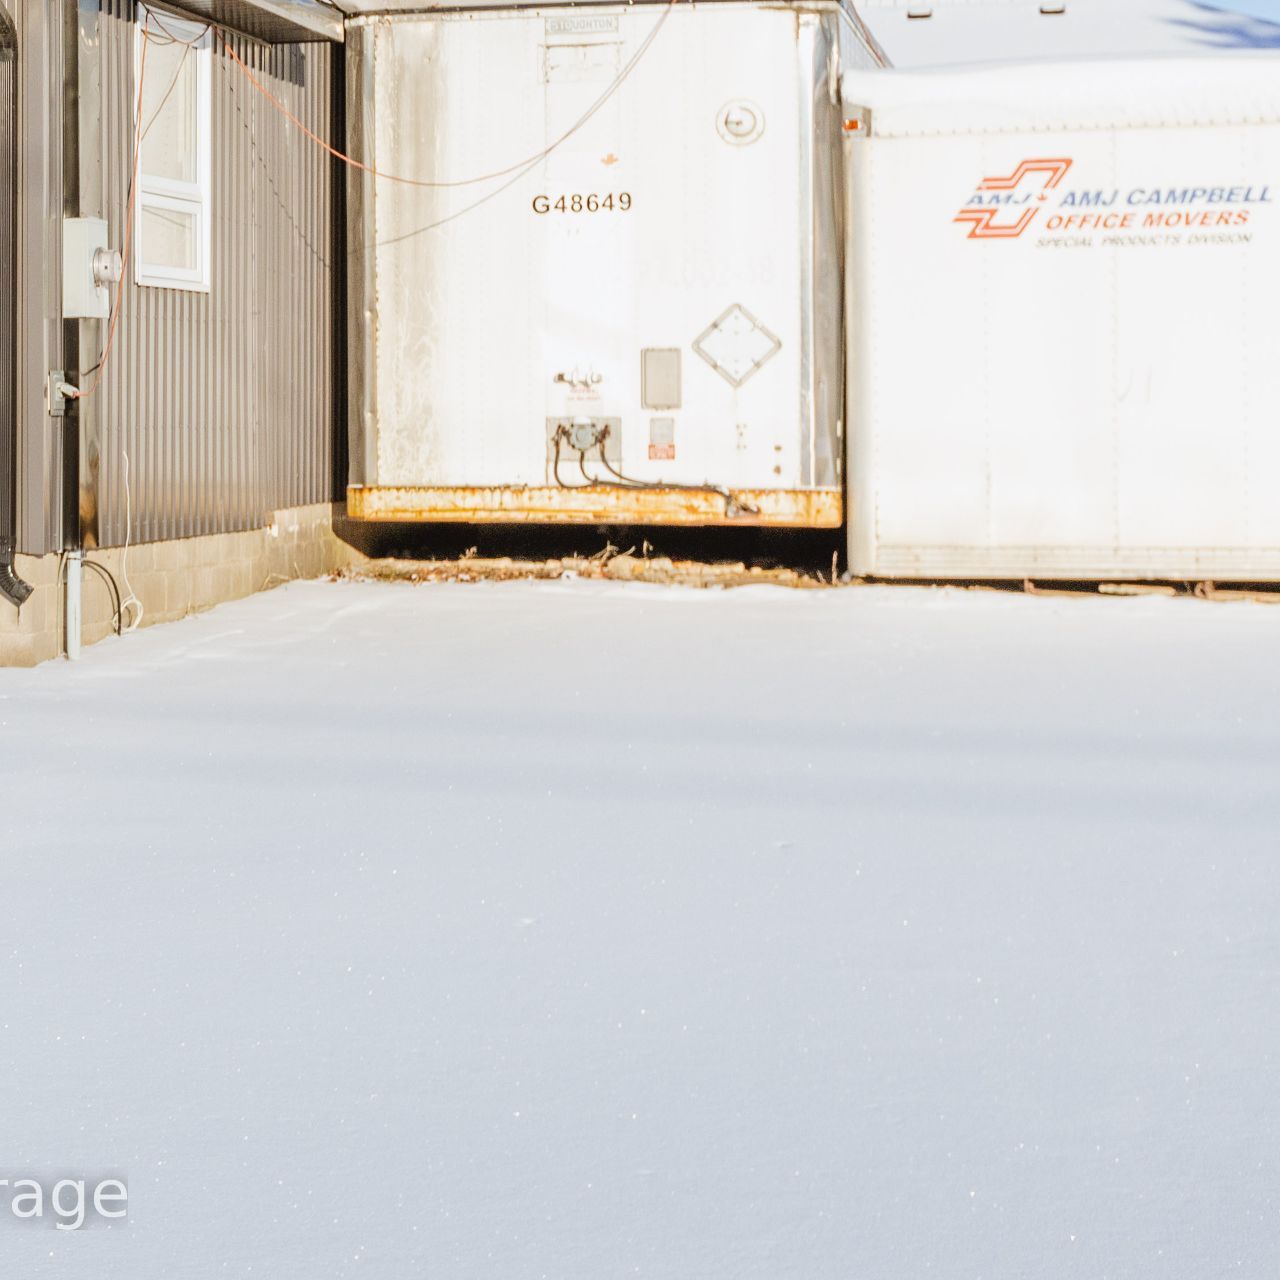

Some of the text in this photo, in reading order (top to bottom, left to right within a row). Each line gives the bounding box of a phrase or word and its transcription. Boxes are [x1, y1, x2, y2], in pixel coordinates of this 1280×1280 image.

[532, 192, 632, 214] G48649
[1060, 185, 1273, 207] AMJ CAMPBELL
[1046, 209, 1250, 230] OFFICE MOVERS
